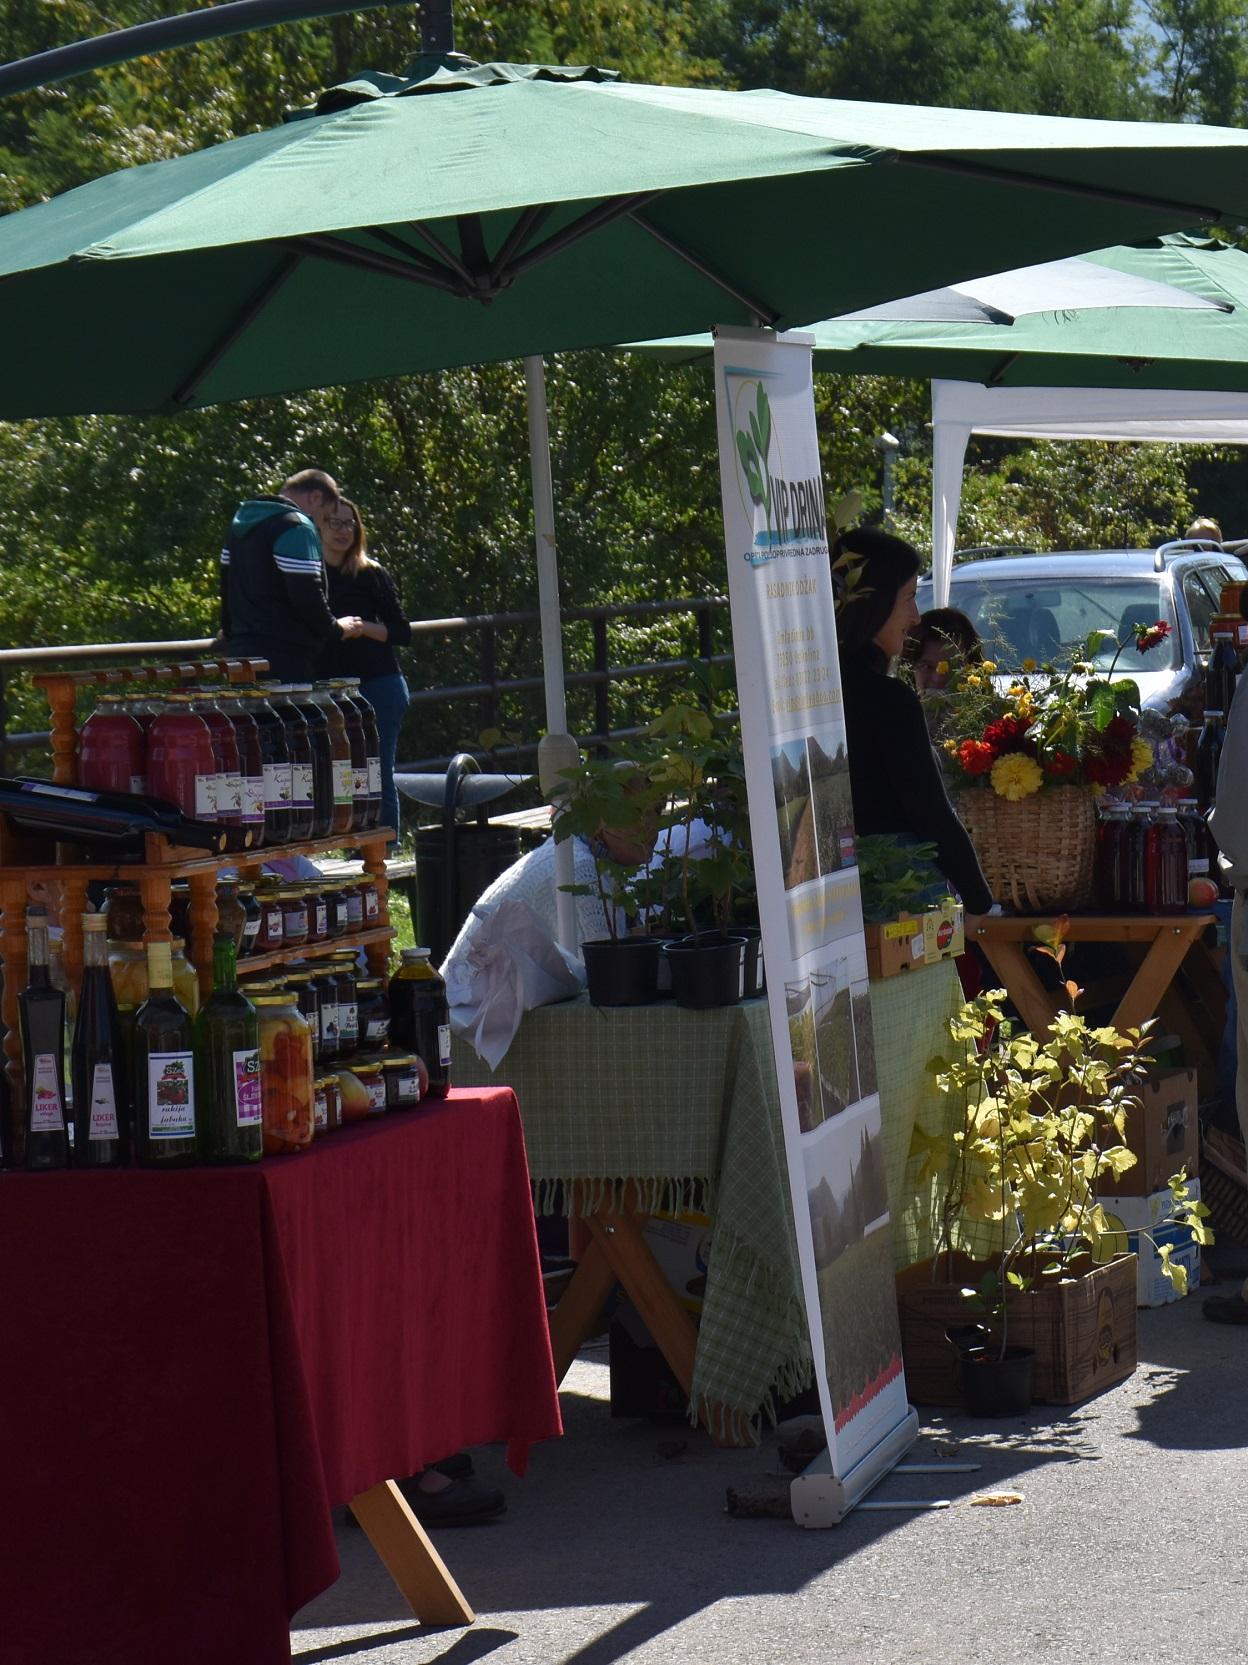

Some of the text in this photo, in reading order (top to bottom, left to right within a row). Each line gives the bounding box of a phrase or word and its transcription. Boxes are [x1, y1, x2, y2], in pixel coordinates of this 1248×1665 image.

[805, 545, 829, 556] ZADRUG
[35, 1103, 58, 1112] LIKER
[92, 1113, 115, 1122] LIKER
